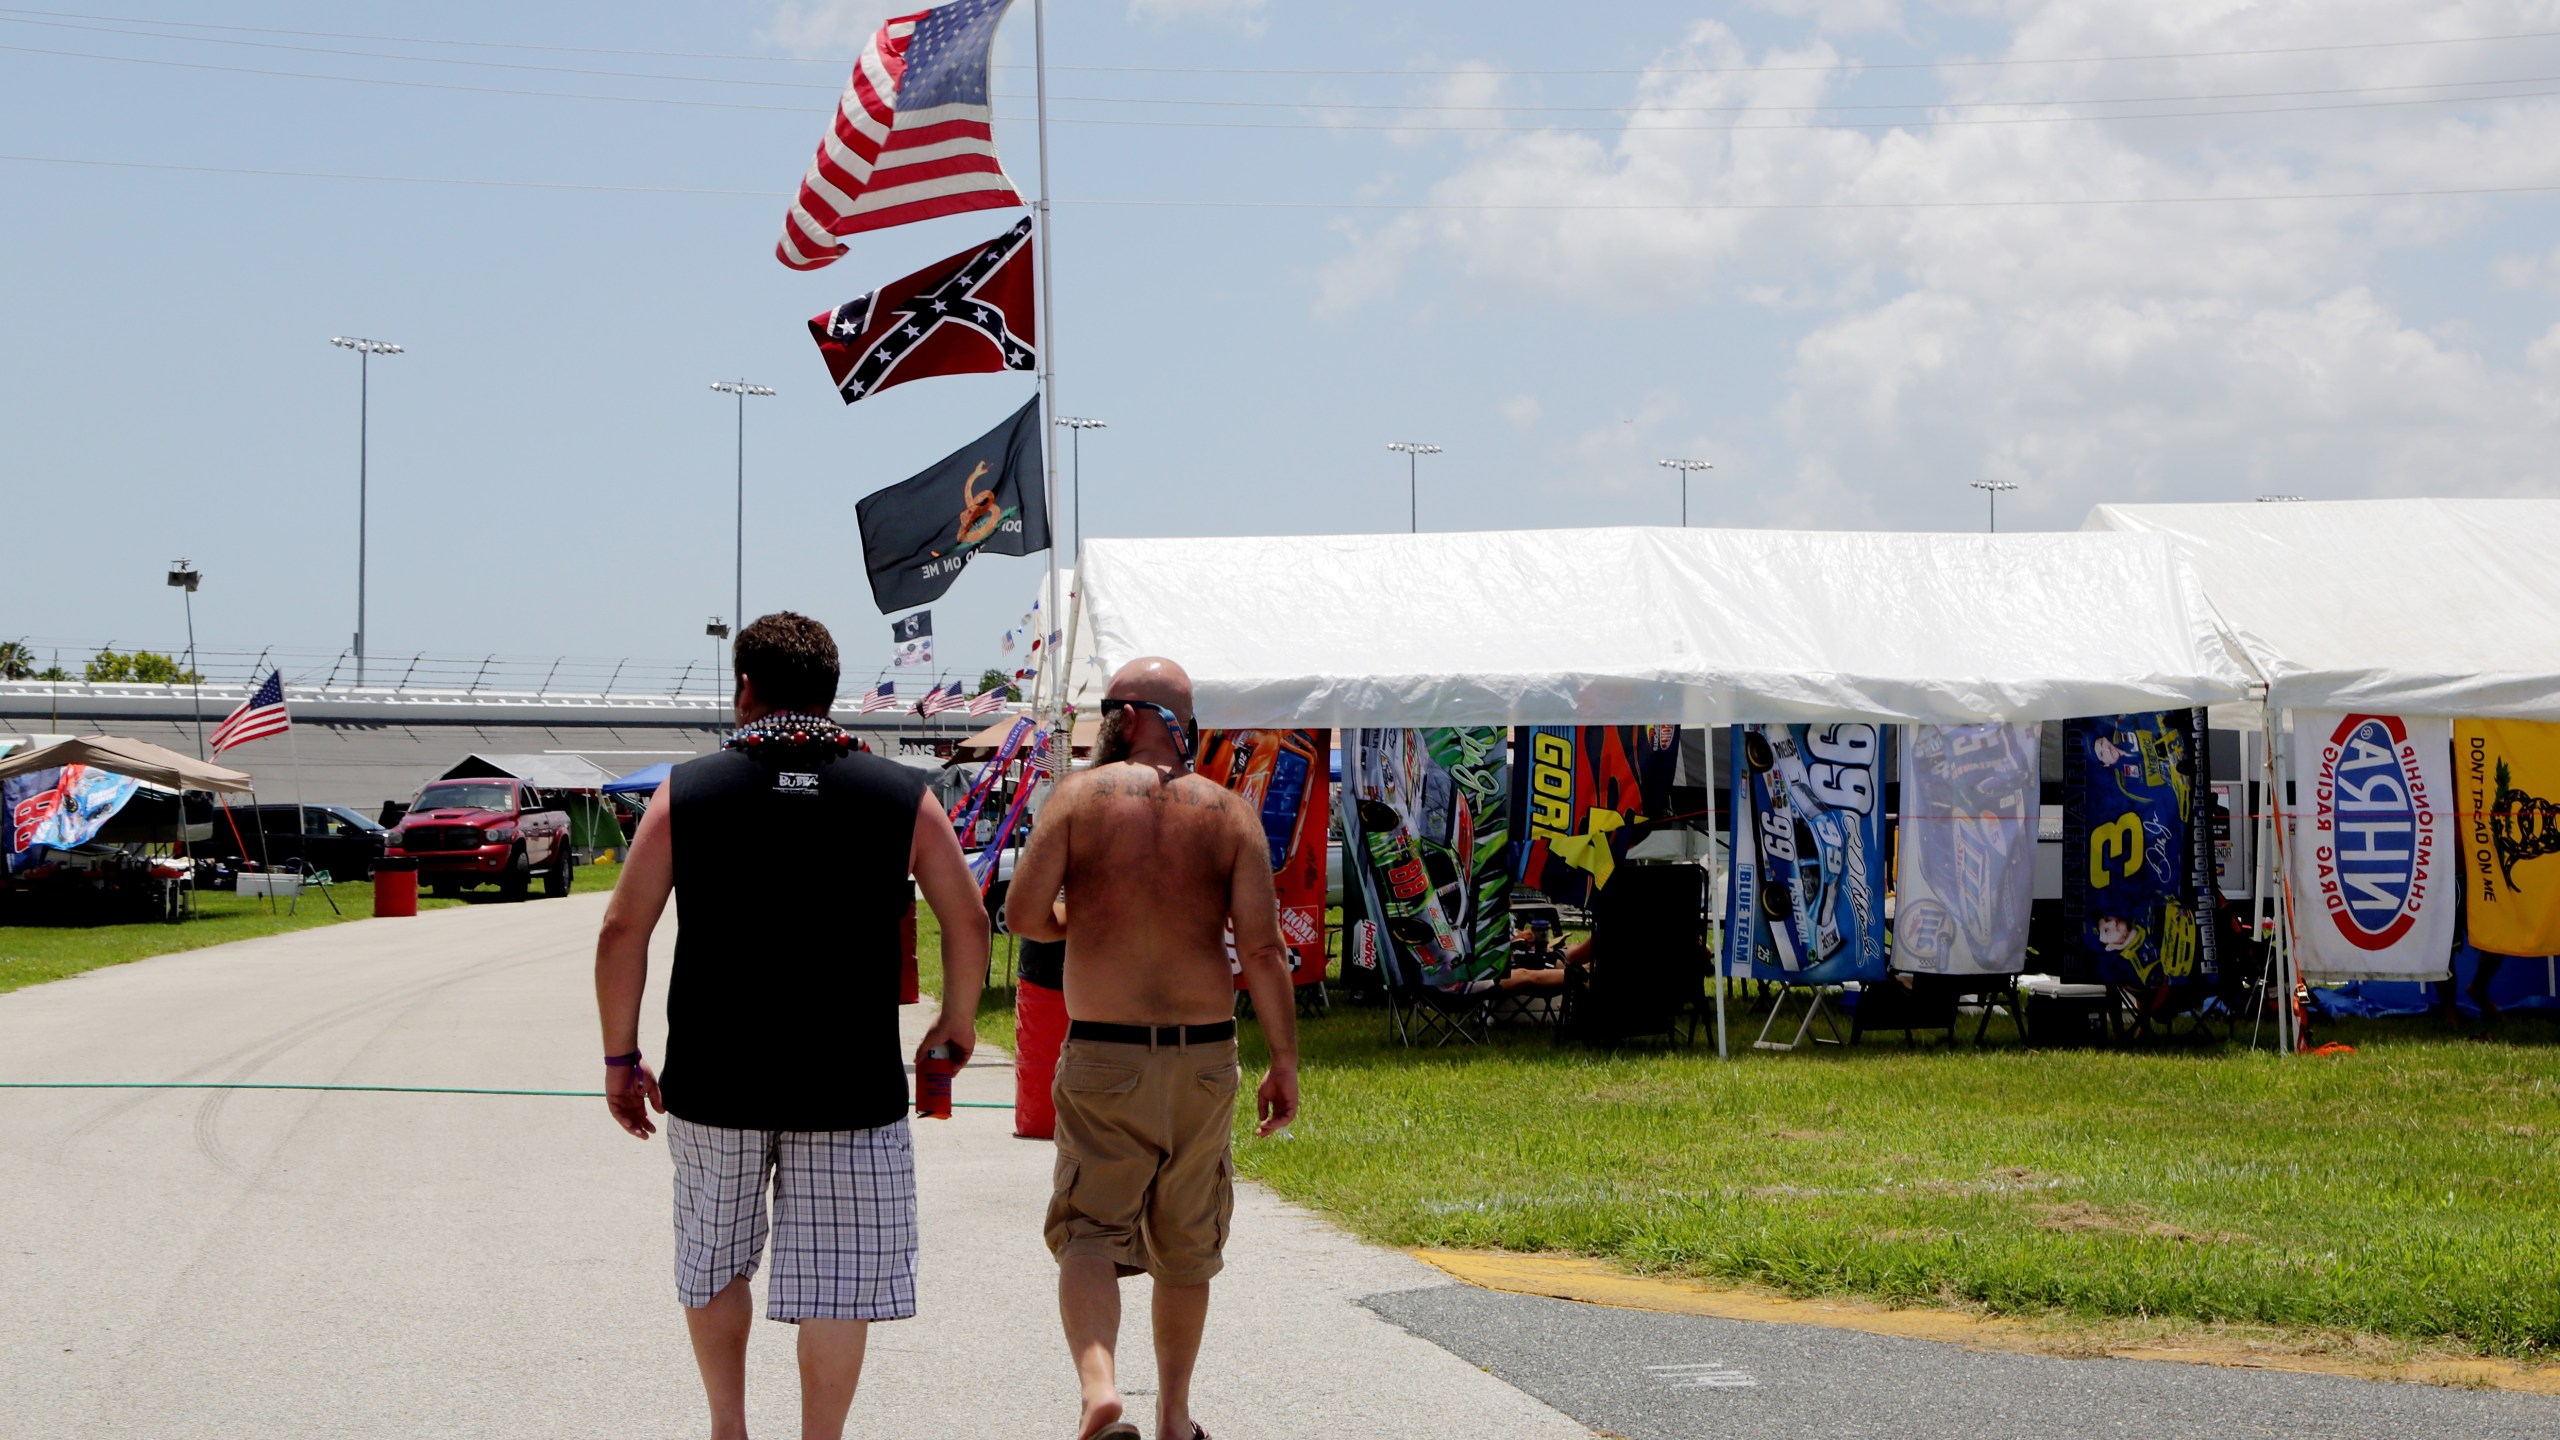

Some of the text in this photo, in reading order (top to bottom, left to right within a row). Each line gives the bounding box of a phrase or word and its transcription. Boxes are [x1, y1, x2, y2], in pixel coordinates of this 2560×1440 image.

[778, 774, 820, 788] BUBBA
[1807, 723, 1877, 816] 99
[2470, 737, 2485, 784] DONT
[1530, 732, 1573, 841] GOR
[1760, 811, 1794, 863] 99
[1816, 821, 1843, 875] 99
[2063, 718, 2087, 978] EARNHARD
[2089, 811, 2145, 890] 3
[2477, 849, 2492, 875] ON
[1738, 870, 1752, 913] BLUE
[1787, 877, 1811, 946] FASTENAL
[2482, 878, 2497, 903] ME
[1282, 907, 1318, 943] HOME
[1300, 909, 1315, 924] THE
[1736, 917, 1751, 962] TEAM
[1363, 921, 1376, 969] Hendrick
